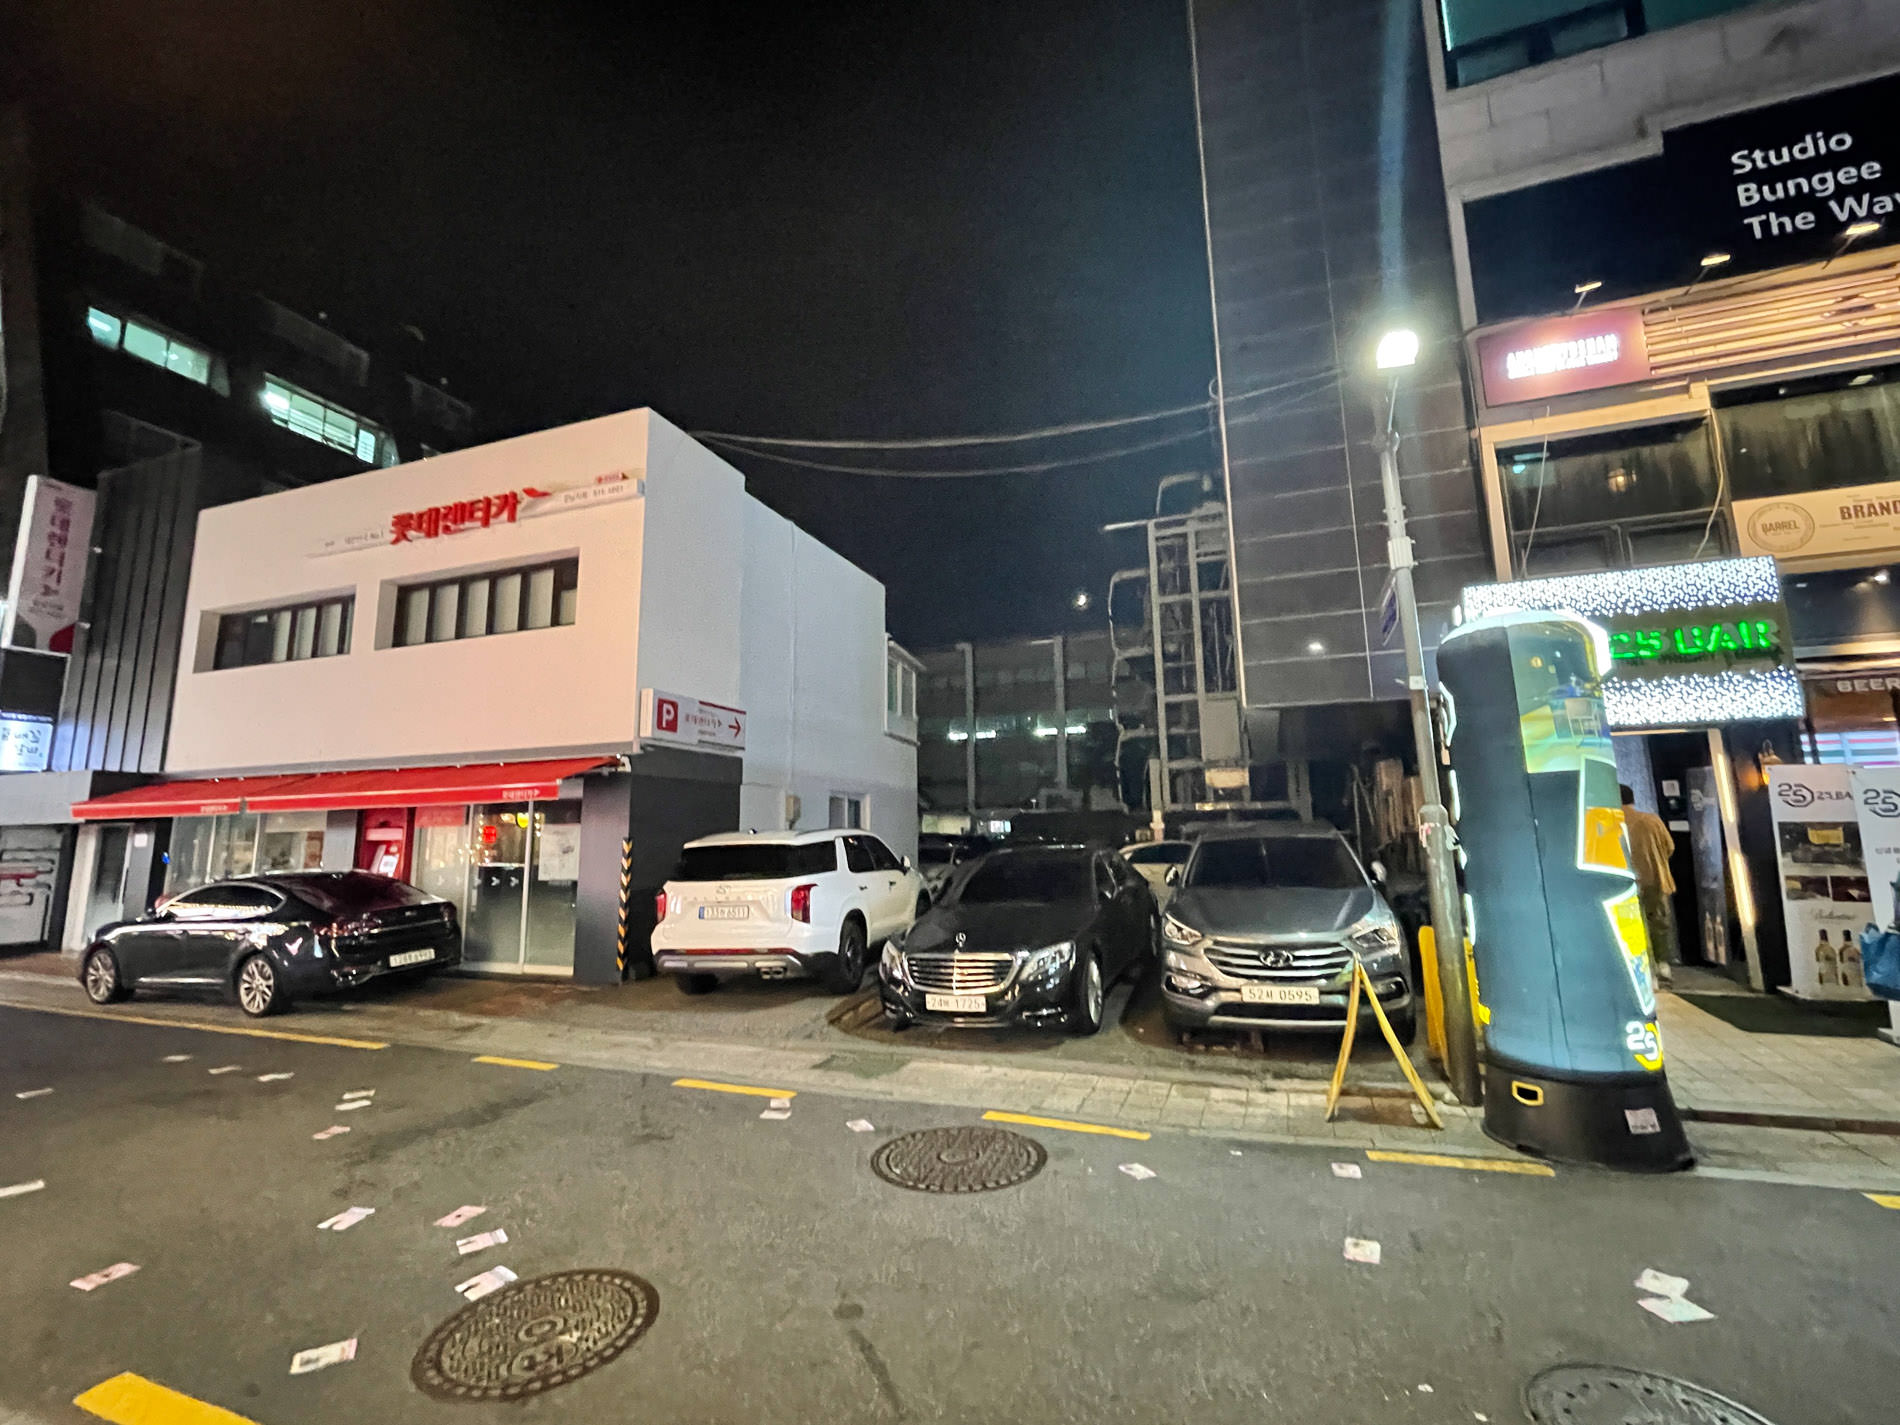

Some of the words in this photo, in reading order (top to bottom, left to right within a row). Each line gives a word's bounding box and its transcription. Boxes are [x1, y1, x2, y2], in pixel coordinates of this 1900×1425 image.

[1731, 131, 1853, 175] Studio
[1736, 160, 1882, 207] Bungee
[1743, 211, 1816, 240] The
[390, 490, 519, 545] 롯데렌터카
[1761, 519, 1800, 536] BARREL
[1674, 617, 1781, 656] BAR
[662, 702, 675, 729] P
[954, 998, 981, 1010] 1725
[1279, 989, 1313, 1002] 0595
[1625, 1021, 1660, 1061] 25
